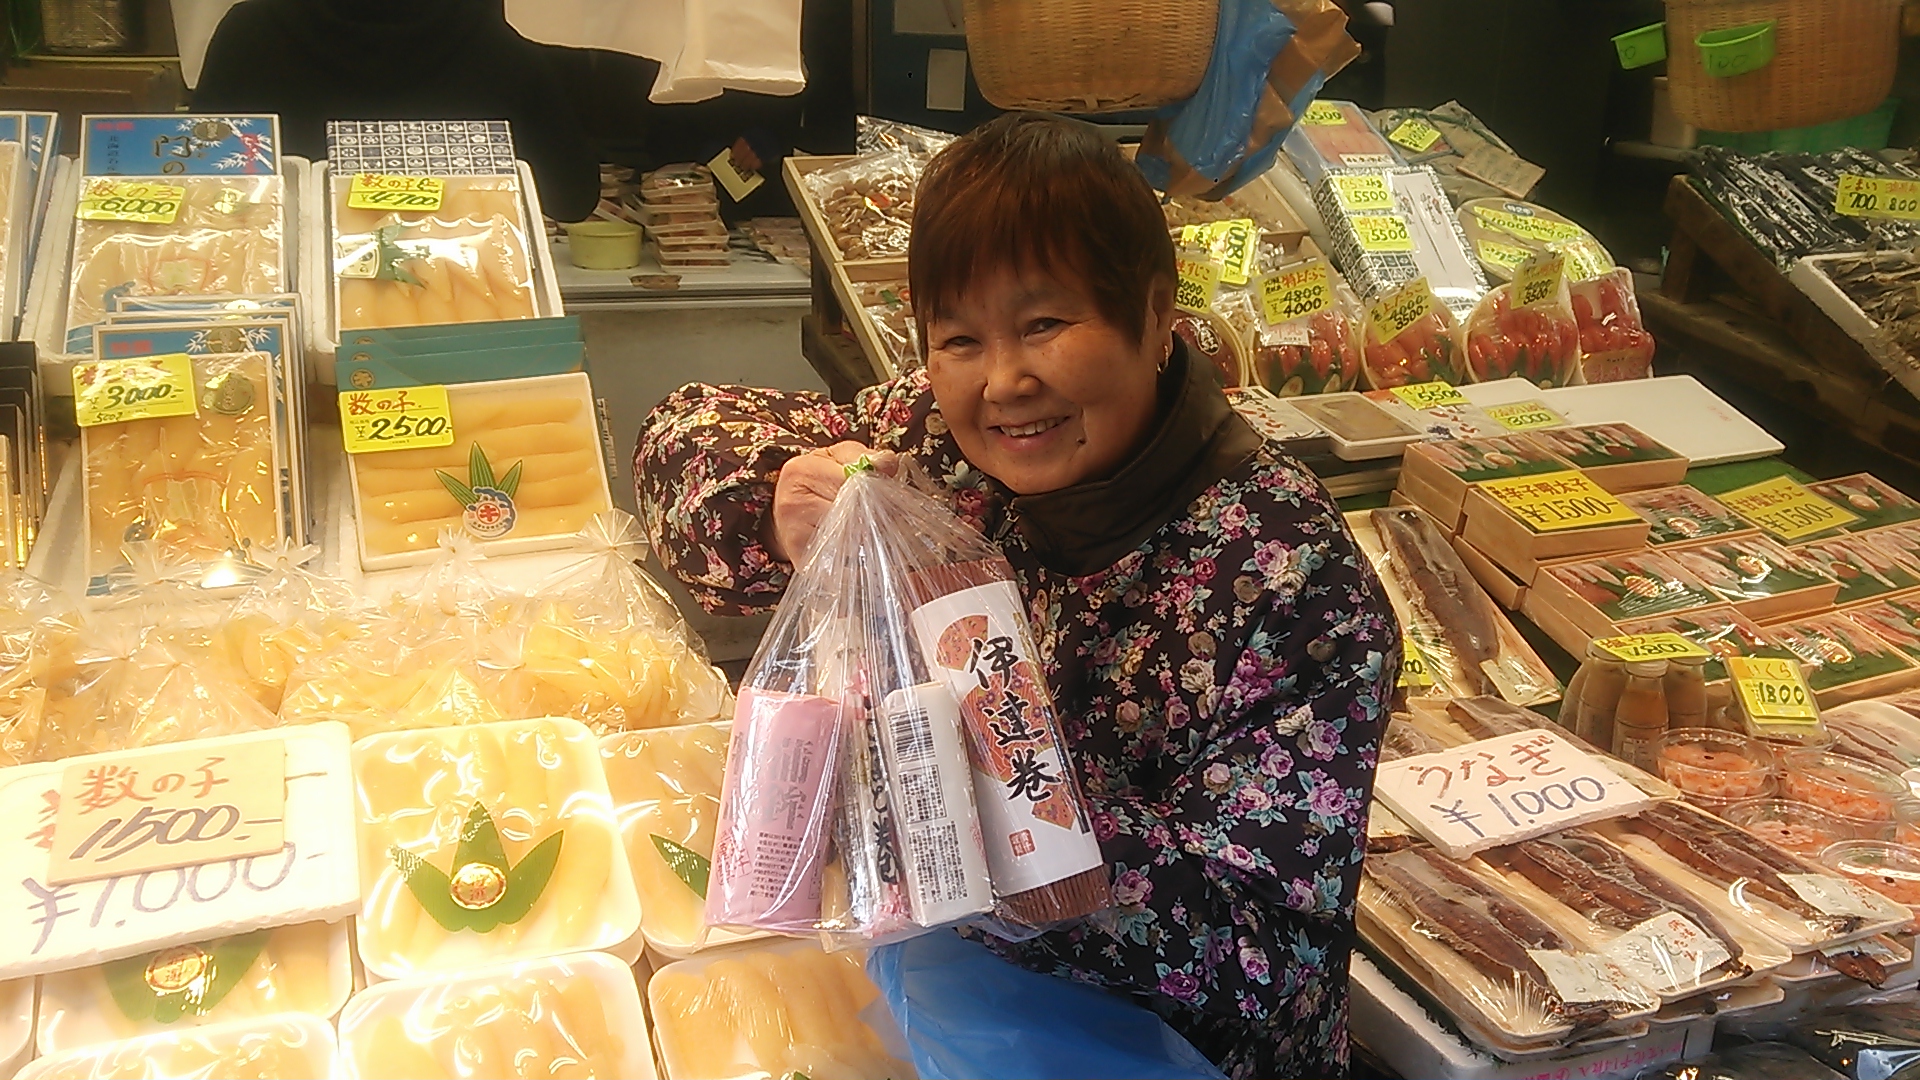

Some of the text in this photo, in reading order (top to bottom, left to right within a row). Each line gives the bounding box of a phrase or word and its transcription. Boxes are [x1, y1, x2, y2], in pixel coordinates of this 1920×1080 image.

[348, 390, 416, 417] 数の子
[968, 635, 1062, 802] 伊達巻
[74, 756, 230, 816] 数の子
[1408, 735, 1567, 799] うなぎ
